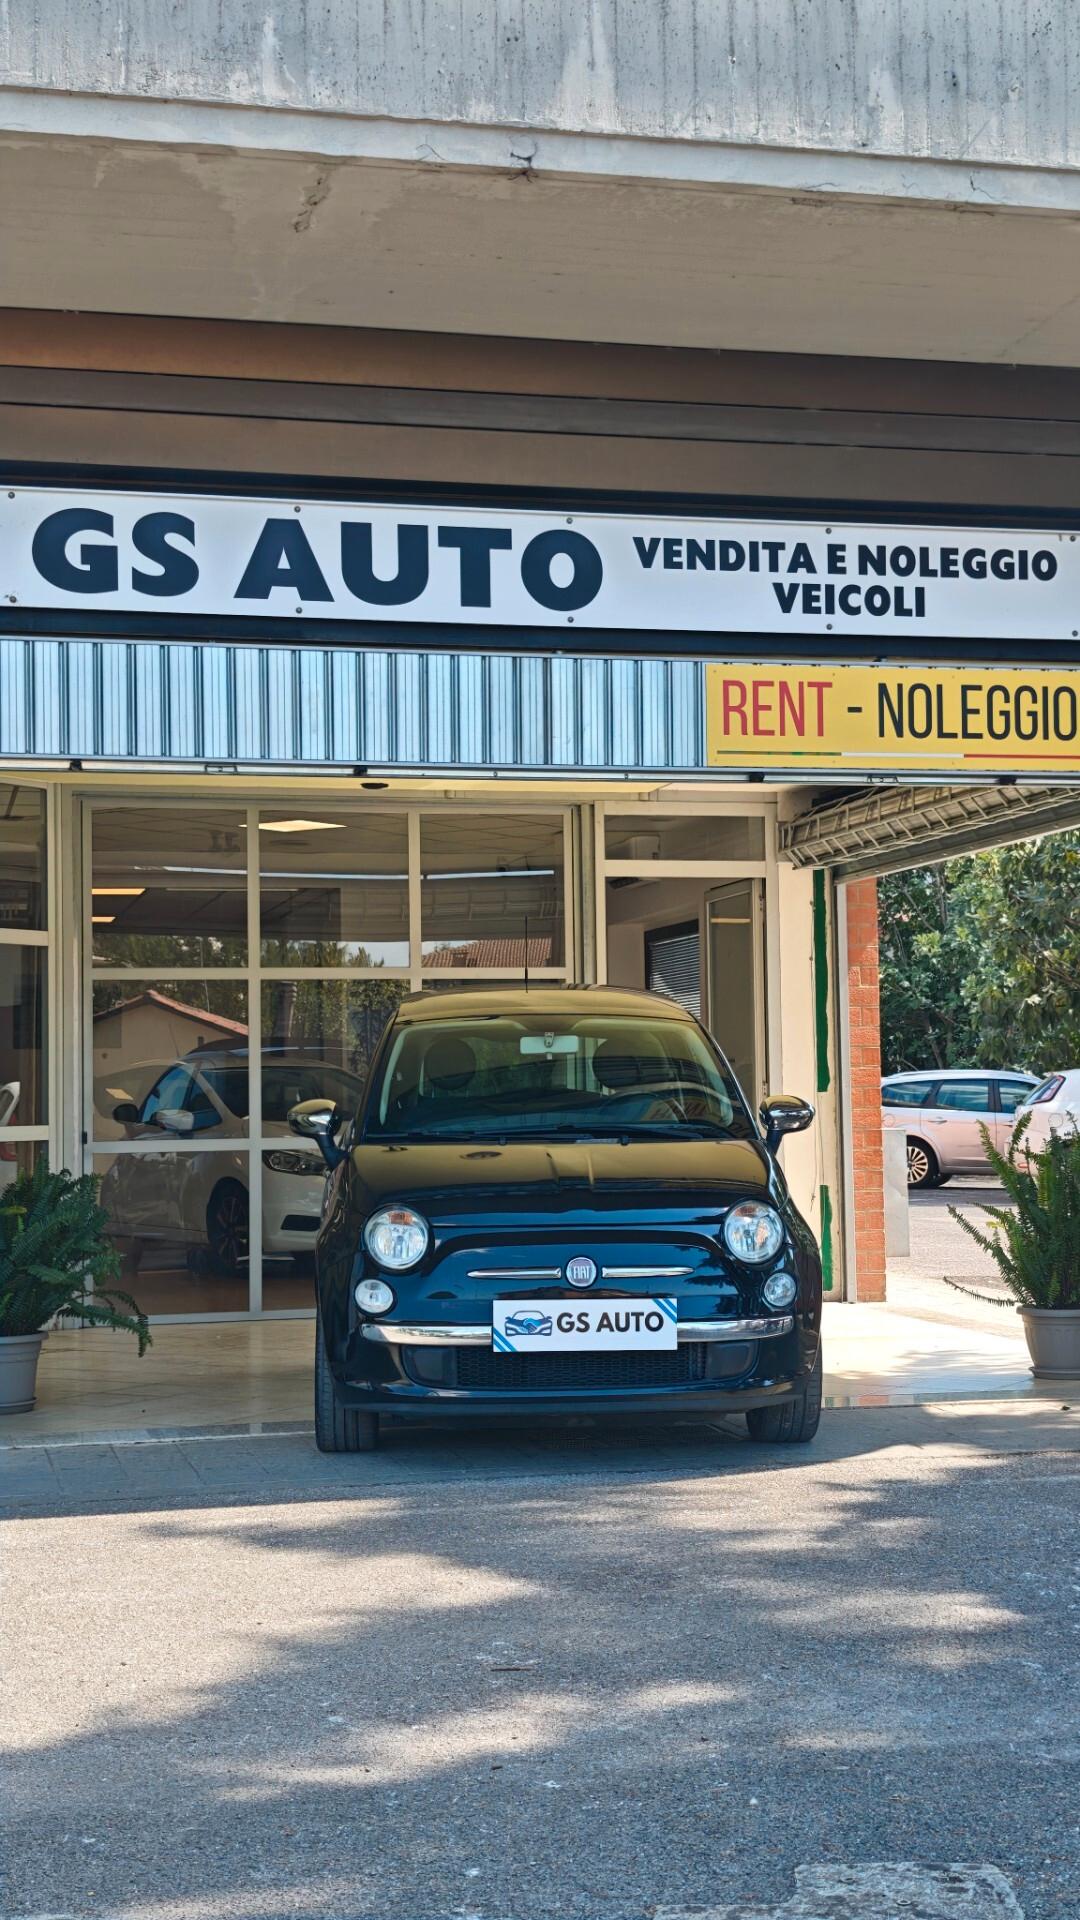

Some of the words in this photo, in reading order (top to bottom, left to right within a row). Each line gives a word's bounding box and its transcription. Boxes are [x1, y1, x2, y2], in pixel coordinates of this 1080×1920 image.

[31, 507, 200, 597] GS
[233, 517, 604, 612] AUTO
[632, 536, 818, 575] VENDITA
[826, 543, 847, 575] E
[857, 544, 1058, 582] NOLEGGIO
[772, 582, 926, 618] VEICOLI
[722, 679, 833, 737] RENT
[877, 682, 1078, 742] NOLEGGIO
[573, 1265, 590, 1279] FIAT
[556, 1311, 591, 1333] GS
[595, 1311, 665, 1333] AUTO
